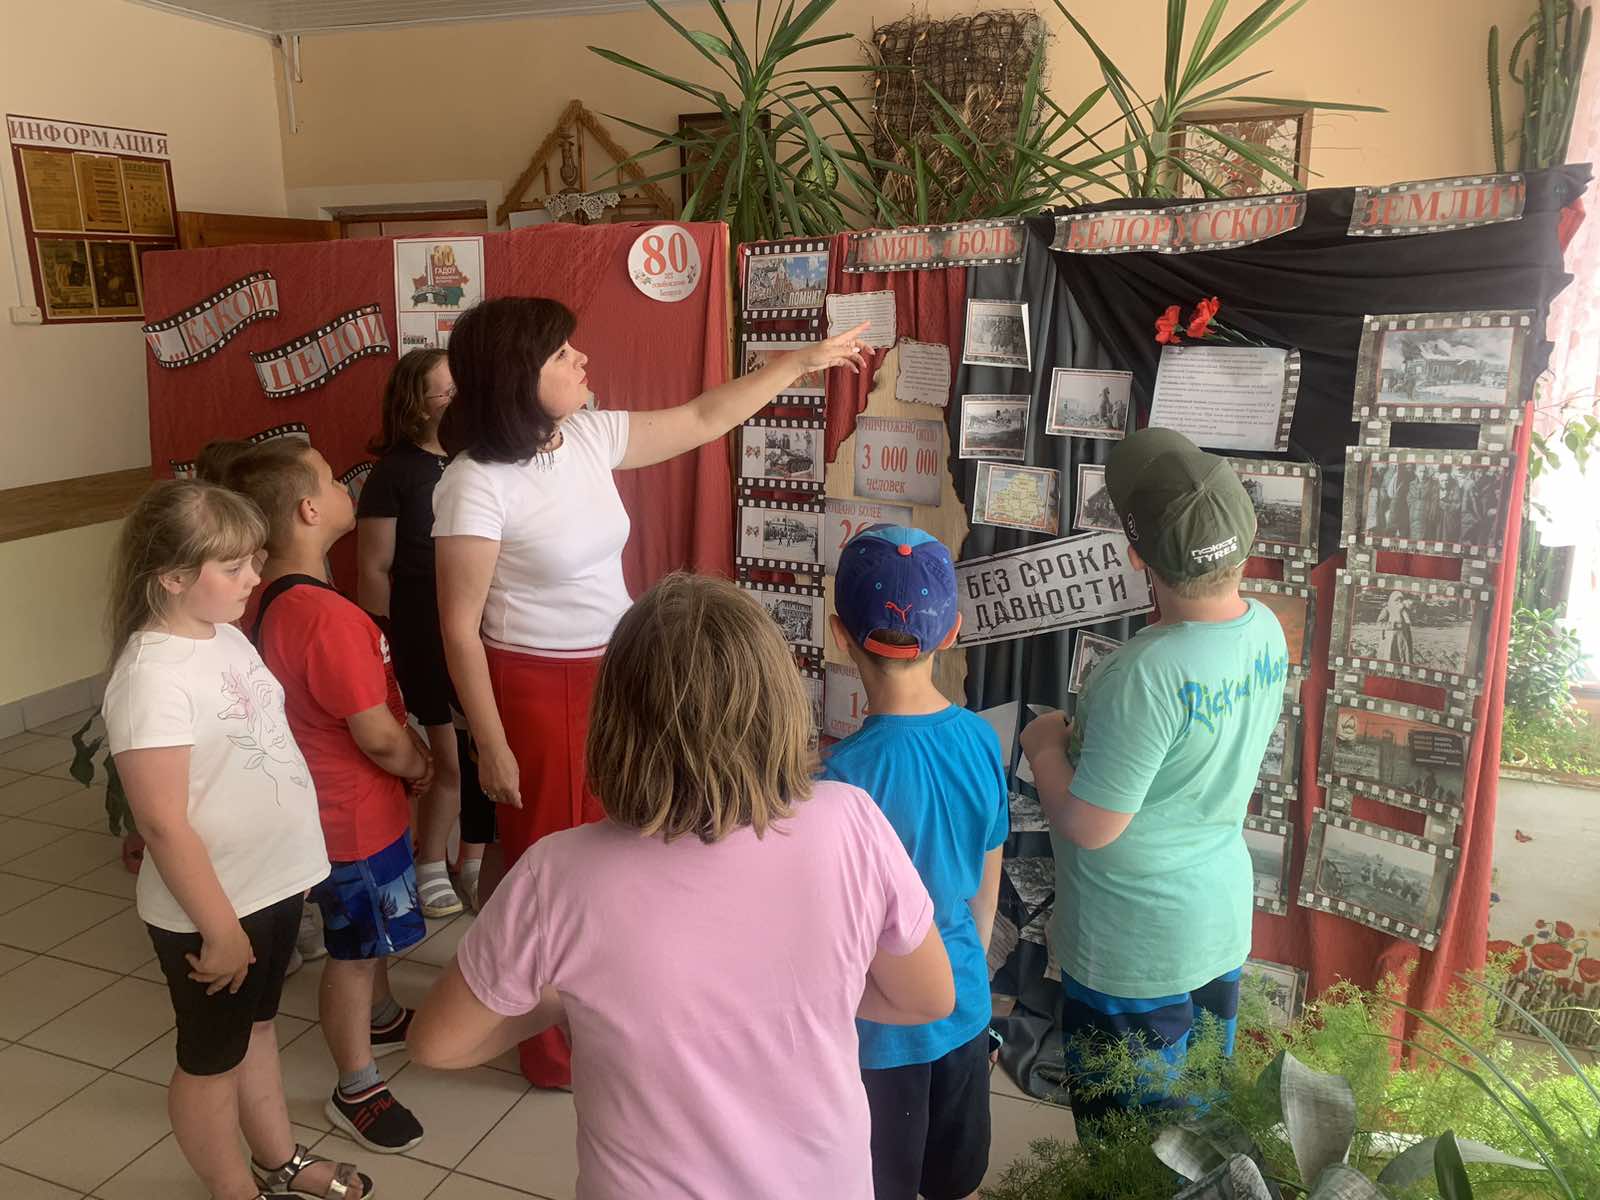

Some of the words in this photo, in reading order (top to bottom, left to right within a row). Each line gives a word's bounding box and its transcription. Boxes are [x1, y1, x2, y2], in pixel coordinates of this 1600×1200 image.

[9, 120, 169, 155] ИНФОРМАЦИЯ
[642, 232, 689, 276] 80
[958, 228, 1018, 257] БОЛЬ
[1066, 195, 1297, 250] БЕЛОРУССКОЙ
[269, 306, 386, 389] ЦЕНОЙ
[862, 443, 872, 470] 3
[881, 445, 908, 473] 000
[916, 447, 938, 477] 000
[966, 568, 1011, 599] БЕЗ
[1019, 542, 1122, 588] СРОКА
[1194, 543, 1238, 564] TYRES
[976, 574, 1128, 631] ДАВНОСТИ
[1178, 678, 1233, 734] Rick
